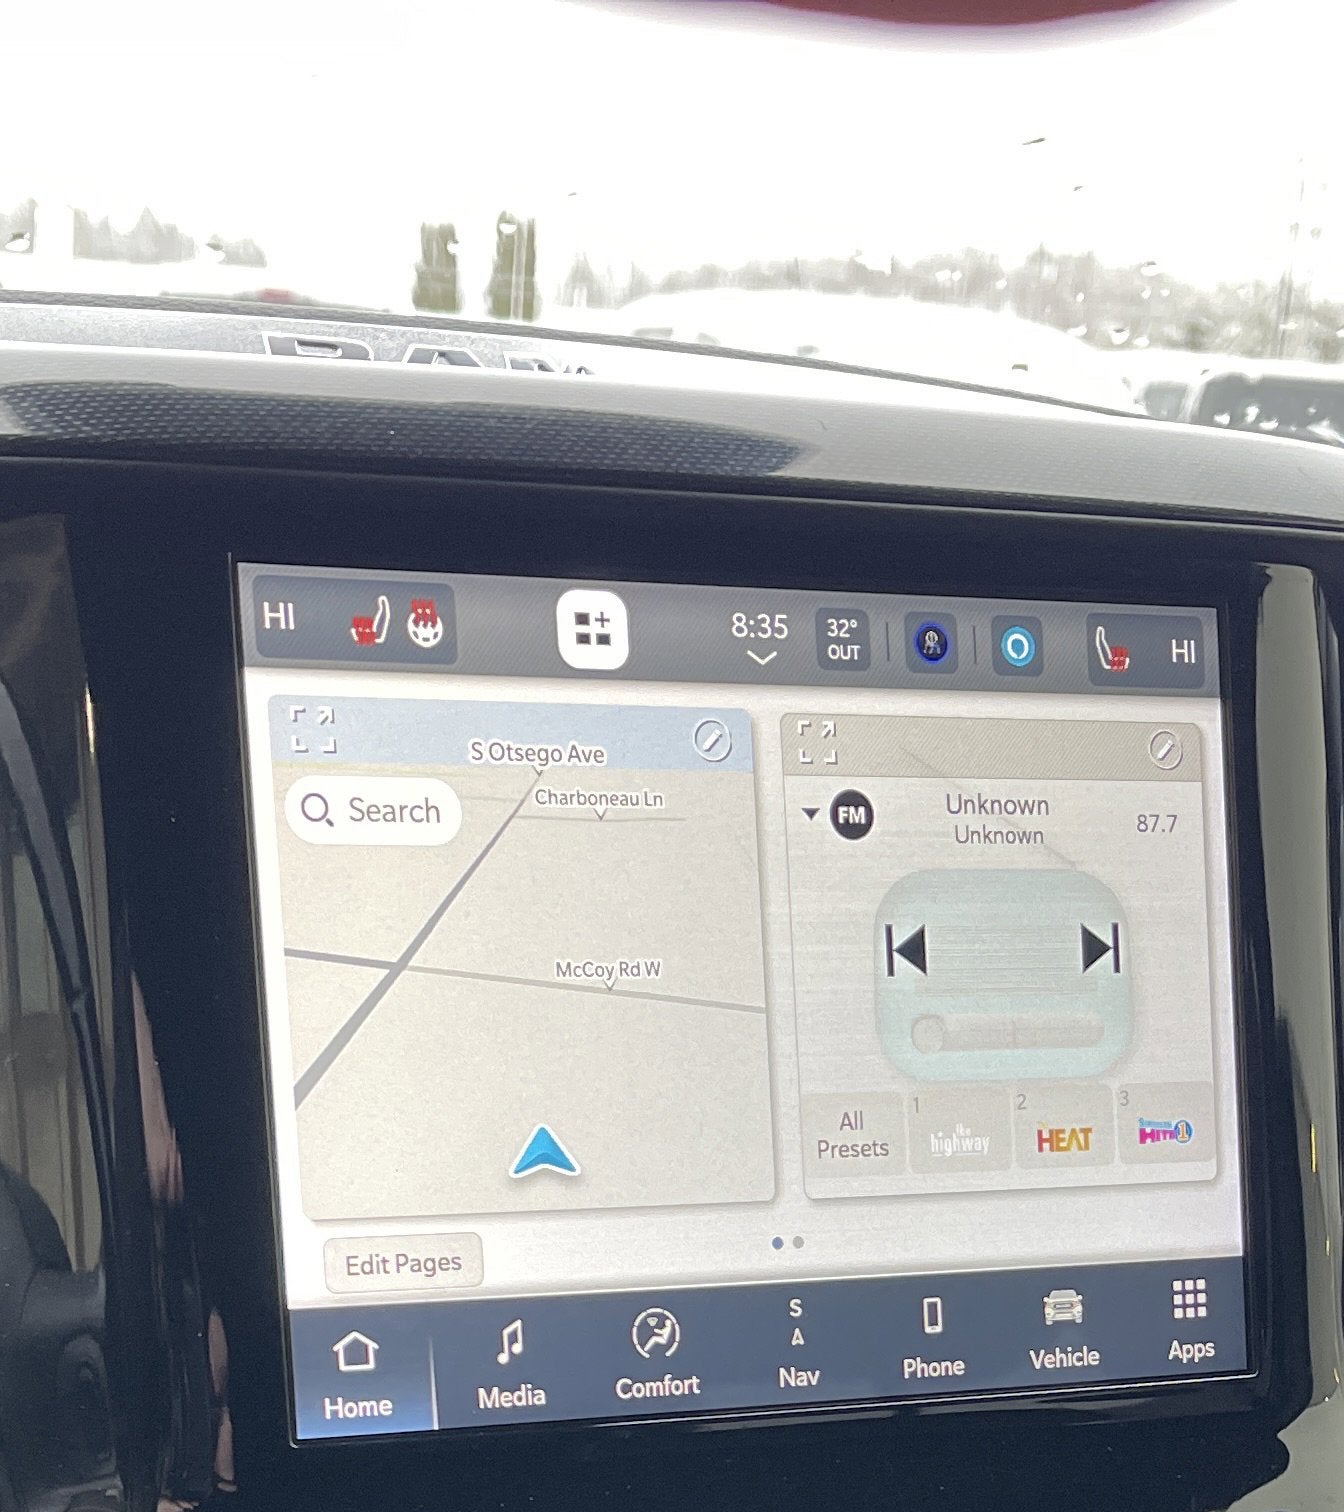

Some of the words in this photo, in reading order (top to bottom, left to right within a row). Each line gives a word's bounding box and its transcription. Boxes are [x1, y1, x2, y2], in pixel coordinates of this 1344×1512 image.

[263, 602, 295, 631] HI
[731, 612, 789, 640] 8:35
[827, 643, 861, 661] OUT
[1171, 639, 1196, 664] HI
[470, 742, 485, 762] S
[489, 742, 563, 767] Otsego
[566, 745, 606, 765] Ave
[534, 788, 639, 808] Charboneau
[643, 791, 664, 808] Ln
[945, 793, 1050, 817] Unknown
[348, 796, 441, 825] Search
[837, 804, 867, 825] FM
[953, 825, 1045, 846] Unknown
[1135, 814, 1178, 834] 87.7
[556, 961, 614, 983] McCoy
[618, 962, 642, 979] Rd
[643, 960, 662, 978] W
[913, 1096, 920, 1114] 1
[1016, 1093, 1027, 1110] 2
[1119, 1090, 1130, 1107] 3
[839, 1110, 864, 1131] All
[817, 1138, 890, 1160] Presets
[930, 1131, 990, 1157] highway
[1037, 1127, 1093, 1152] HEAT
[345, 1254, 390, 1277] Edit
[394, 1252, 463, 1279] Pages
[1029, 1345, 1101, 1371] Vehicle
[1168, 1339, 1216, 1365] Apps
[778, 1366, 821, 1388] Nav
[902, 1356, 966, 1380] Phone
[477, 1385, 546, 1409] Media
[615, 1374, 701, 1399] Comfort
[323, 1396, 394, 1419] Home
